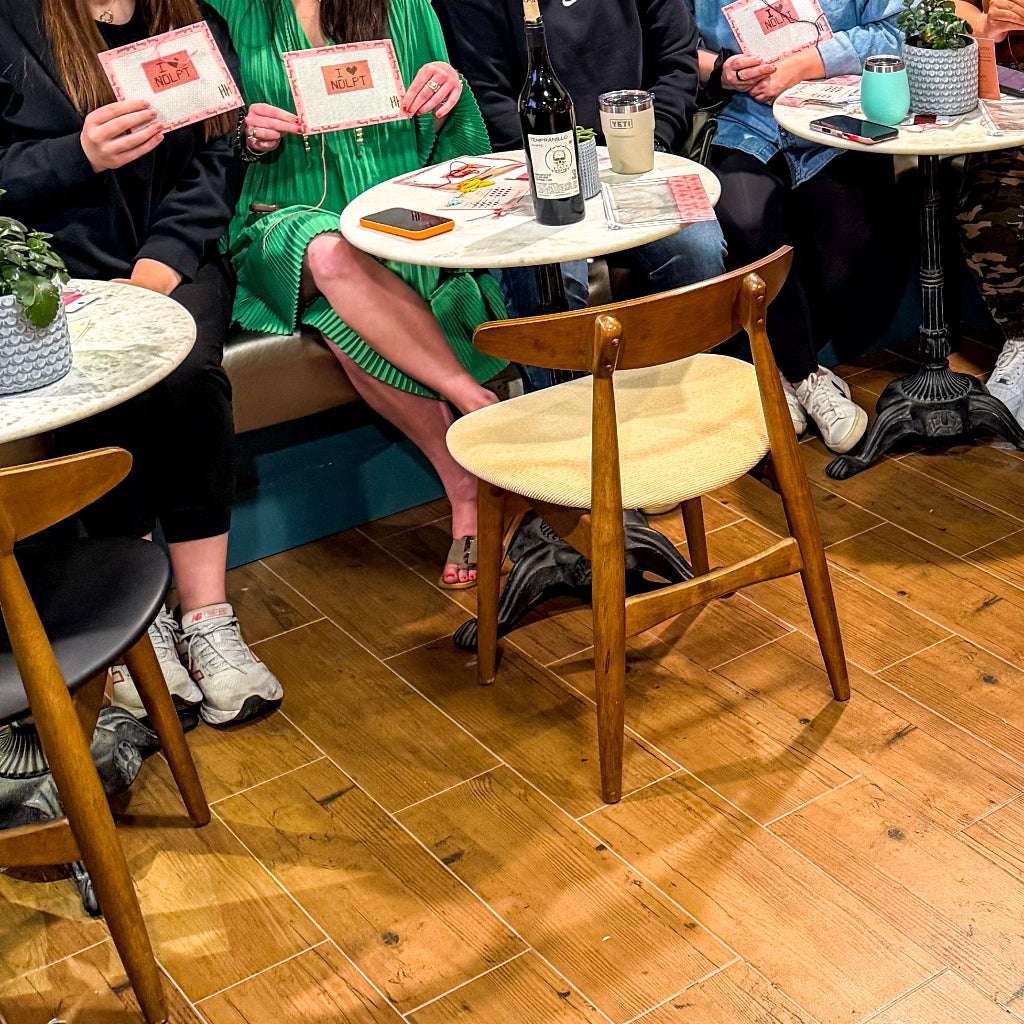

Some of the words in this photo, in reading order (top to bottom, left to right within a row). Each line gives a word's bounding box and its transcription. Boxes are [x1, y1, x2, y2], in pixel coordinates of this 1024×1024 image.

[765, 8, 774, 18] I
[156, 62, 166, 74] I
[335, 68, 343, 78] I
[154, 66, 191, 88] NDLPT
[330, 76, 366, 90] NDLPT
